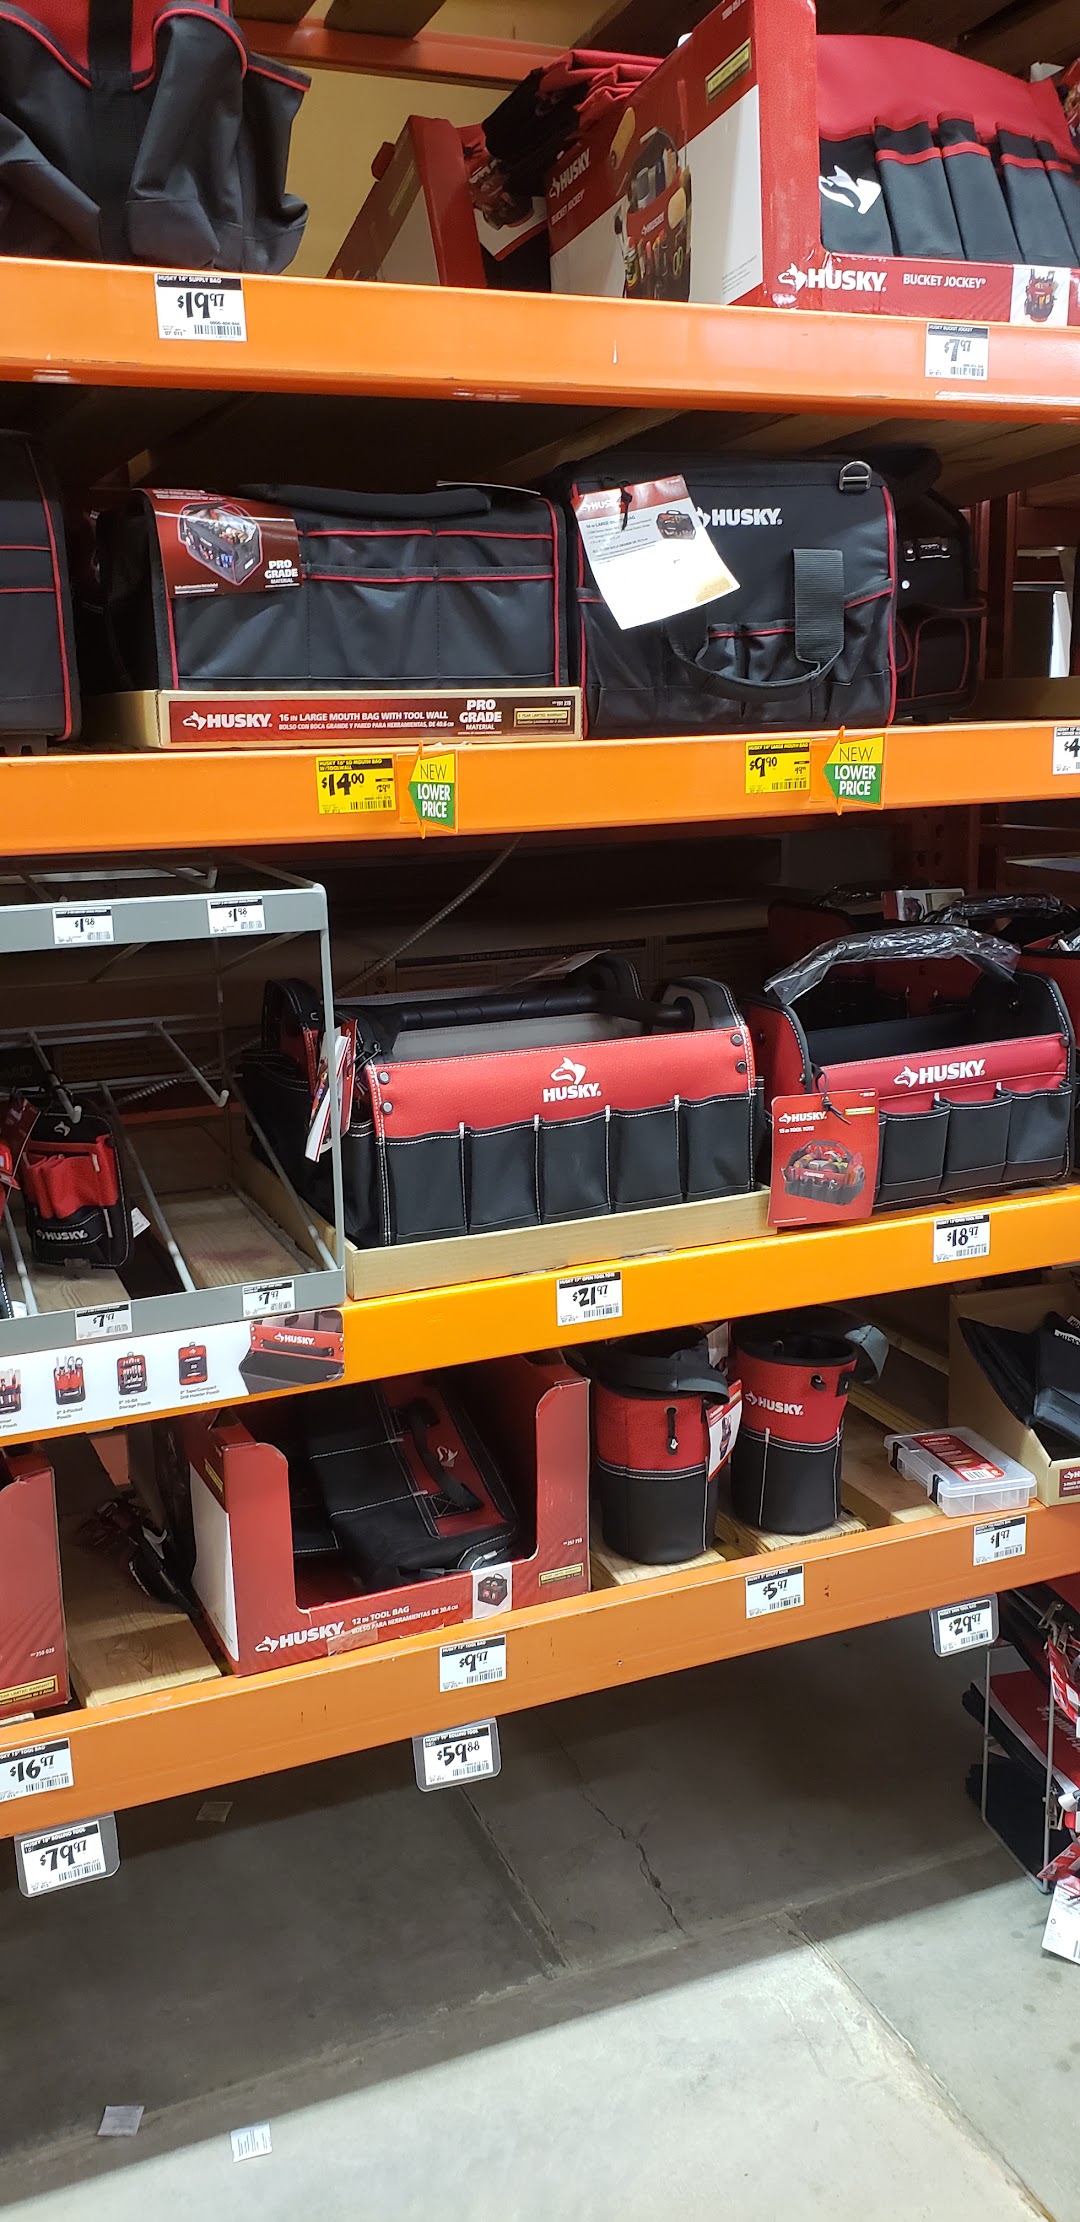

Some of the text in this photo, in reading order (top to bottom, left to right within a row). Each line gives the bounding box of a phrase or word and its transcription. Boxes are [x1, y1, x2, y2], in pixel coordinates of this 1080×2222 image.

[560, 147, 591, 192] HUSKY
[808, 269, 887, 292] HUSKY
[903, 273, 943, 287] BUCKET
[711, 507, 782, 527] HUSKY
[268, 559, 293, 569] PRO
[264, 568, 299, 579] GRADE
[466, 699, 497, 711] PRO
[207, 713, 273, 729] HUSKY
[279, 714, 289, 722] 16
[299, 713, 328, 722] LARGE
[330, 712, 360, 721] MOUTH
[361, 712, 380, 721] BAG
[381, 712, 402, 721] WITH
[403, 711, 425, 720] TOOL
[426, 711, 449, 720] WALL
[459, 711, 502, 723] GRADE
[326, 722, 349, 730] GRANDE
[465, 723, 495, 731] MATERIAL
[839, 746, 874, 762] NEW
[420, 763, 448, 781] NEW
[834, 764, 877, 781] LOWER
[417, 784, 451, 801] LOWER
[839, 780, 871, 796] PRICE
[422, 801, 447, 819] PRICE
[919, 1058, 986, 1085] HUSKY
[543, 1082, 602, 1103] HUSKY
[791, 1111, 827, 1123] HUSKY
[45, 1229, 89, 1241] HUSKY
[284, 1334, 315, 1346] HUSKY
[758, 1396, 804, 1416] HUSKY
[351, 1617, 362, 1626] 12
[369, 1610, 391, 1622] TOOL
[392, 1605, 410, 1617] BAG
[371, 1620, 387, 1631] PARA
[388, 1611, 431, 1627] HERRAMIENTAS
[431, 1609, 439, 1617] DE
[279, 1621, 345, 1649] HUSKY
